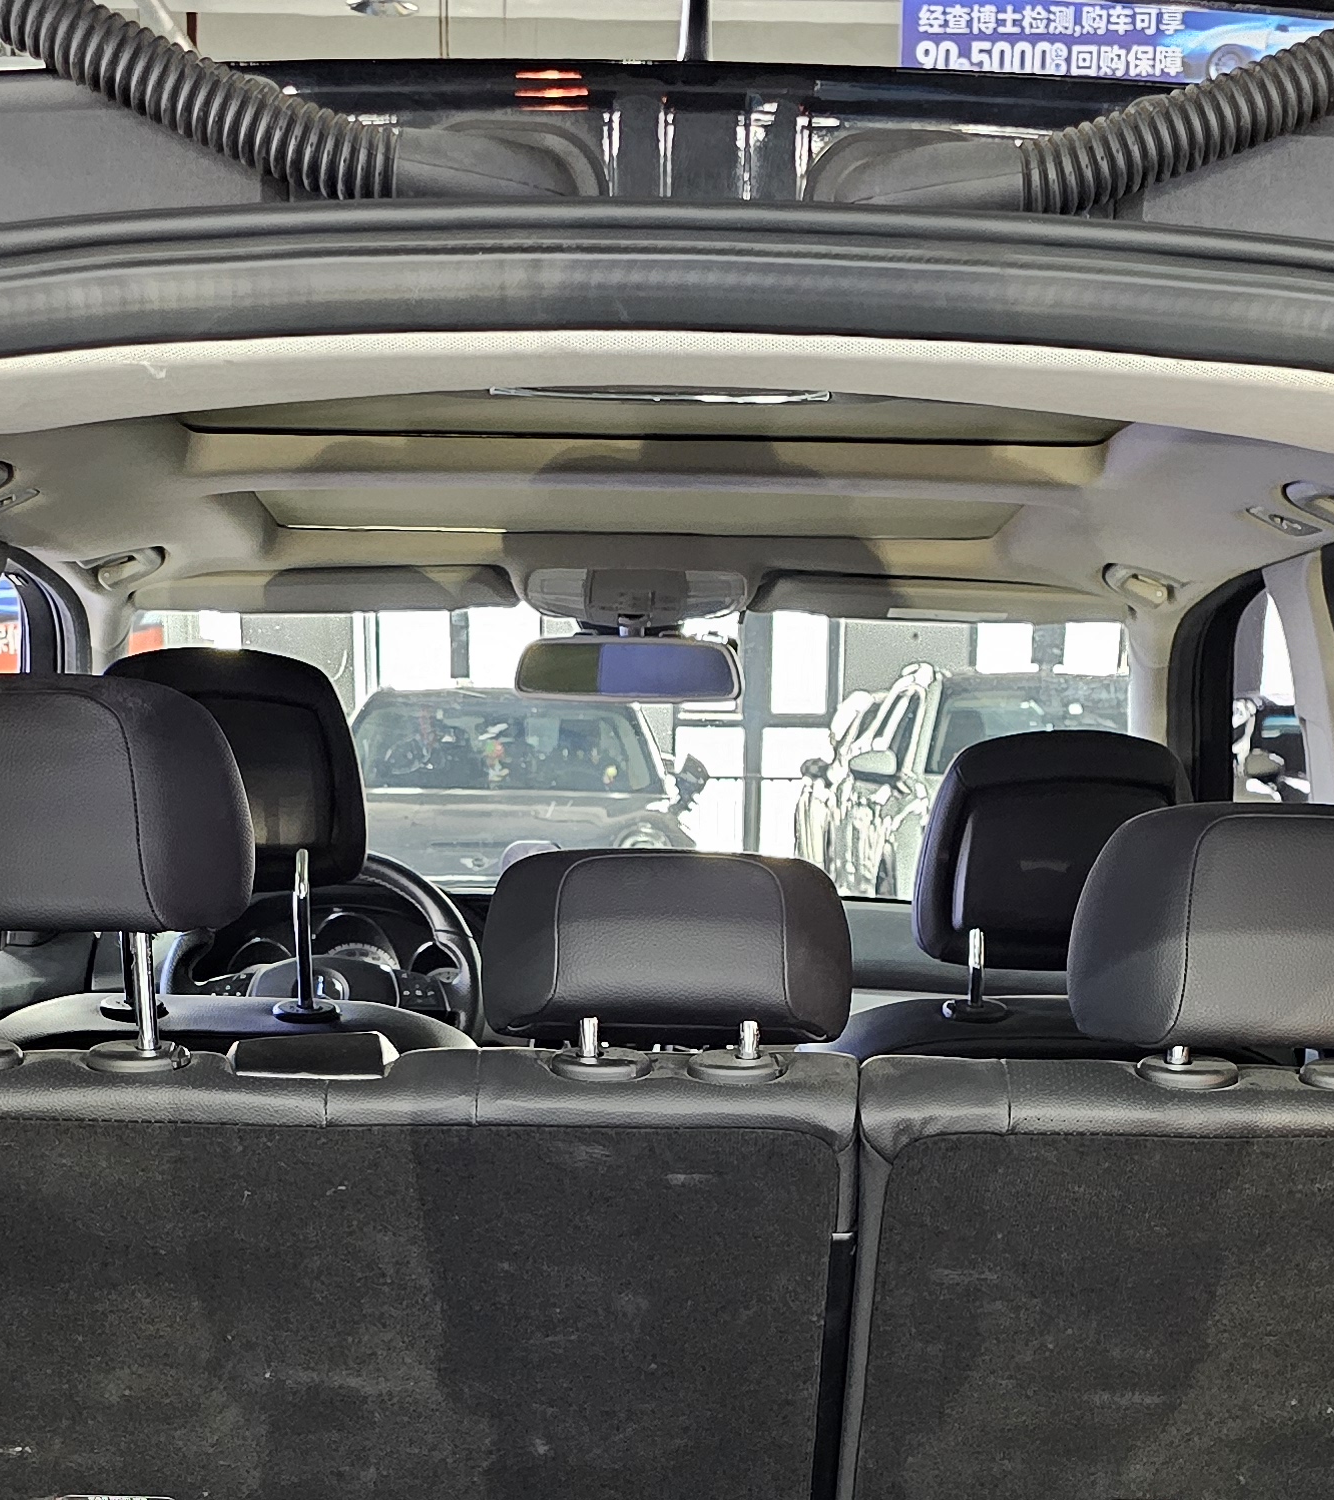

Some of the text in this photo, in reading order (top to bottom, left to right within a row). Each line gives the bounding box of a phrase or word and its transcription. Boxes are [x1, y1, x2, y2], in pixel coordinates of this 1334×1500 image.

[917, 4, 1186, 38] 经查博士检测,购车可享
